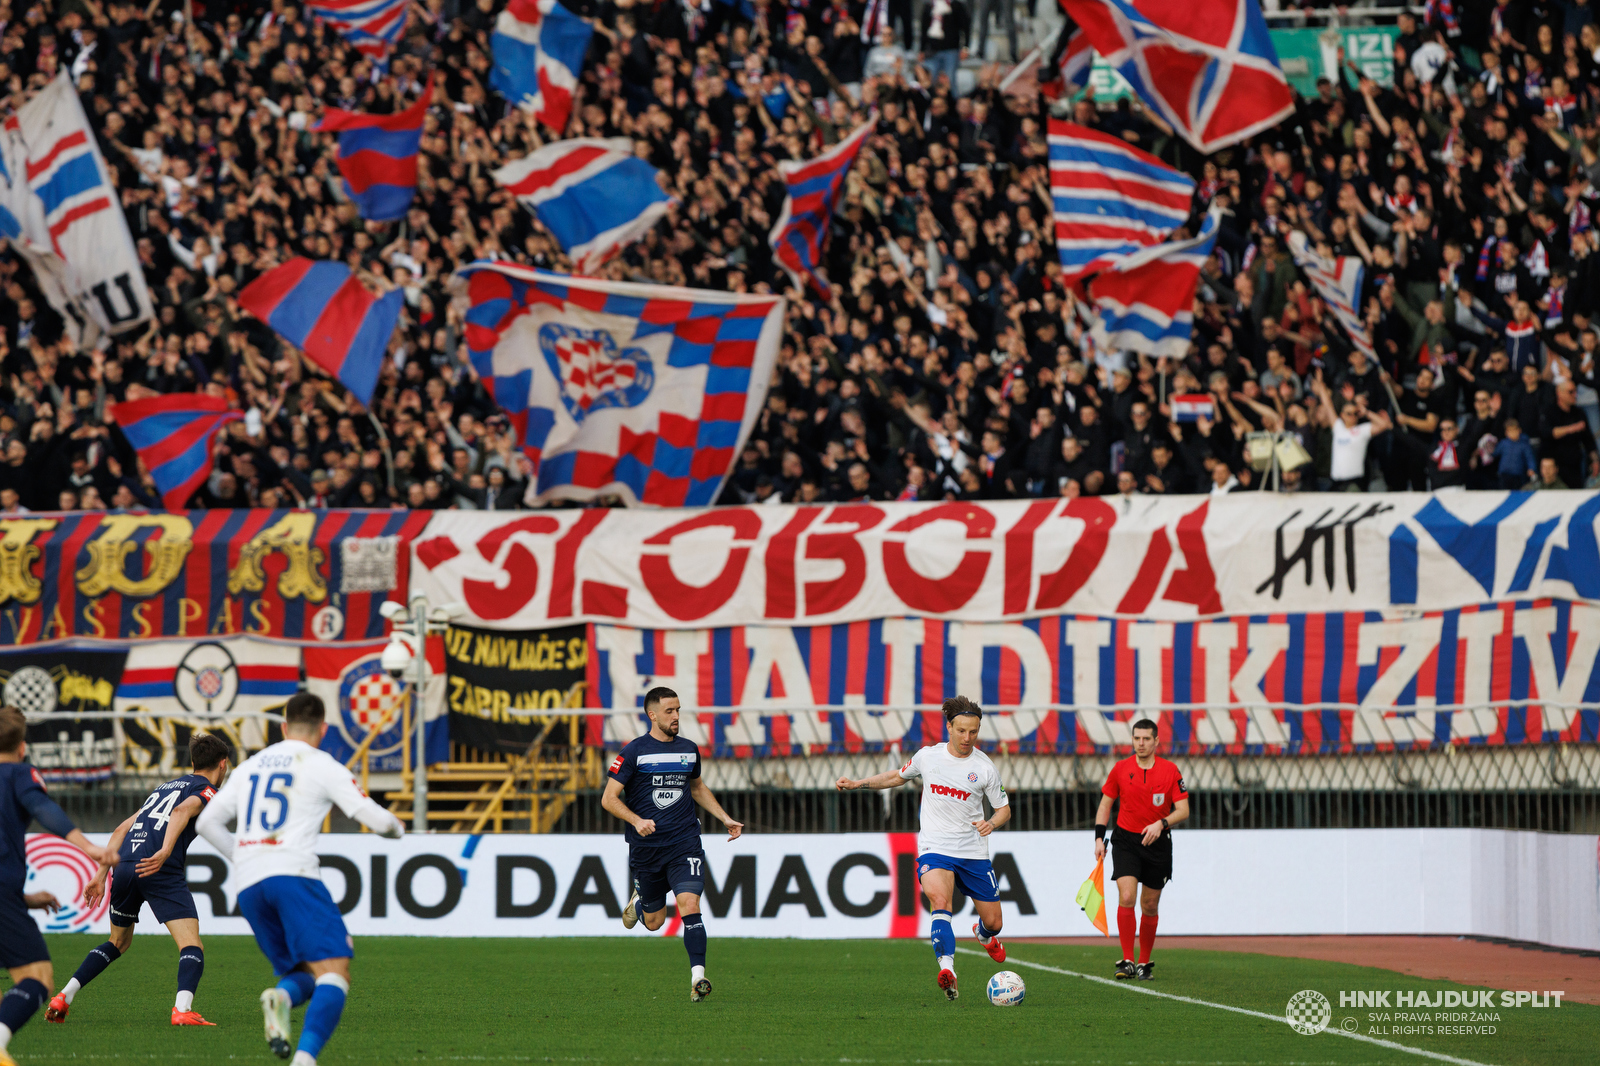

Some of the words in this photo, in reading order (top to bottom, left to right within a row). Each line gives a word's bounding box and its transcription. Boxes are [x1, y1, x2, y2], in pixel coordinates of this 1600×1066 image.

[463, 499, 1223, 621] SLOBODA
[595, 616, 1291, 746] HAJDUK
[129, 789, 181, 832] 24
[246, 772, 293, 832] 15
[657, 791, 674, 799] MOL
[920, 783, 972, 802] TOMMY
[186, 853, 462, 919] RDIO
[495, 852, 1038, 919] DAMACIA
[687, 857, 702, 876] 17
